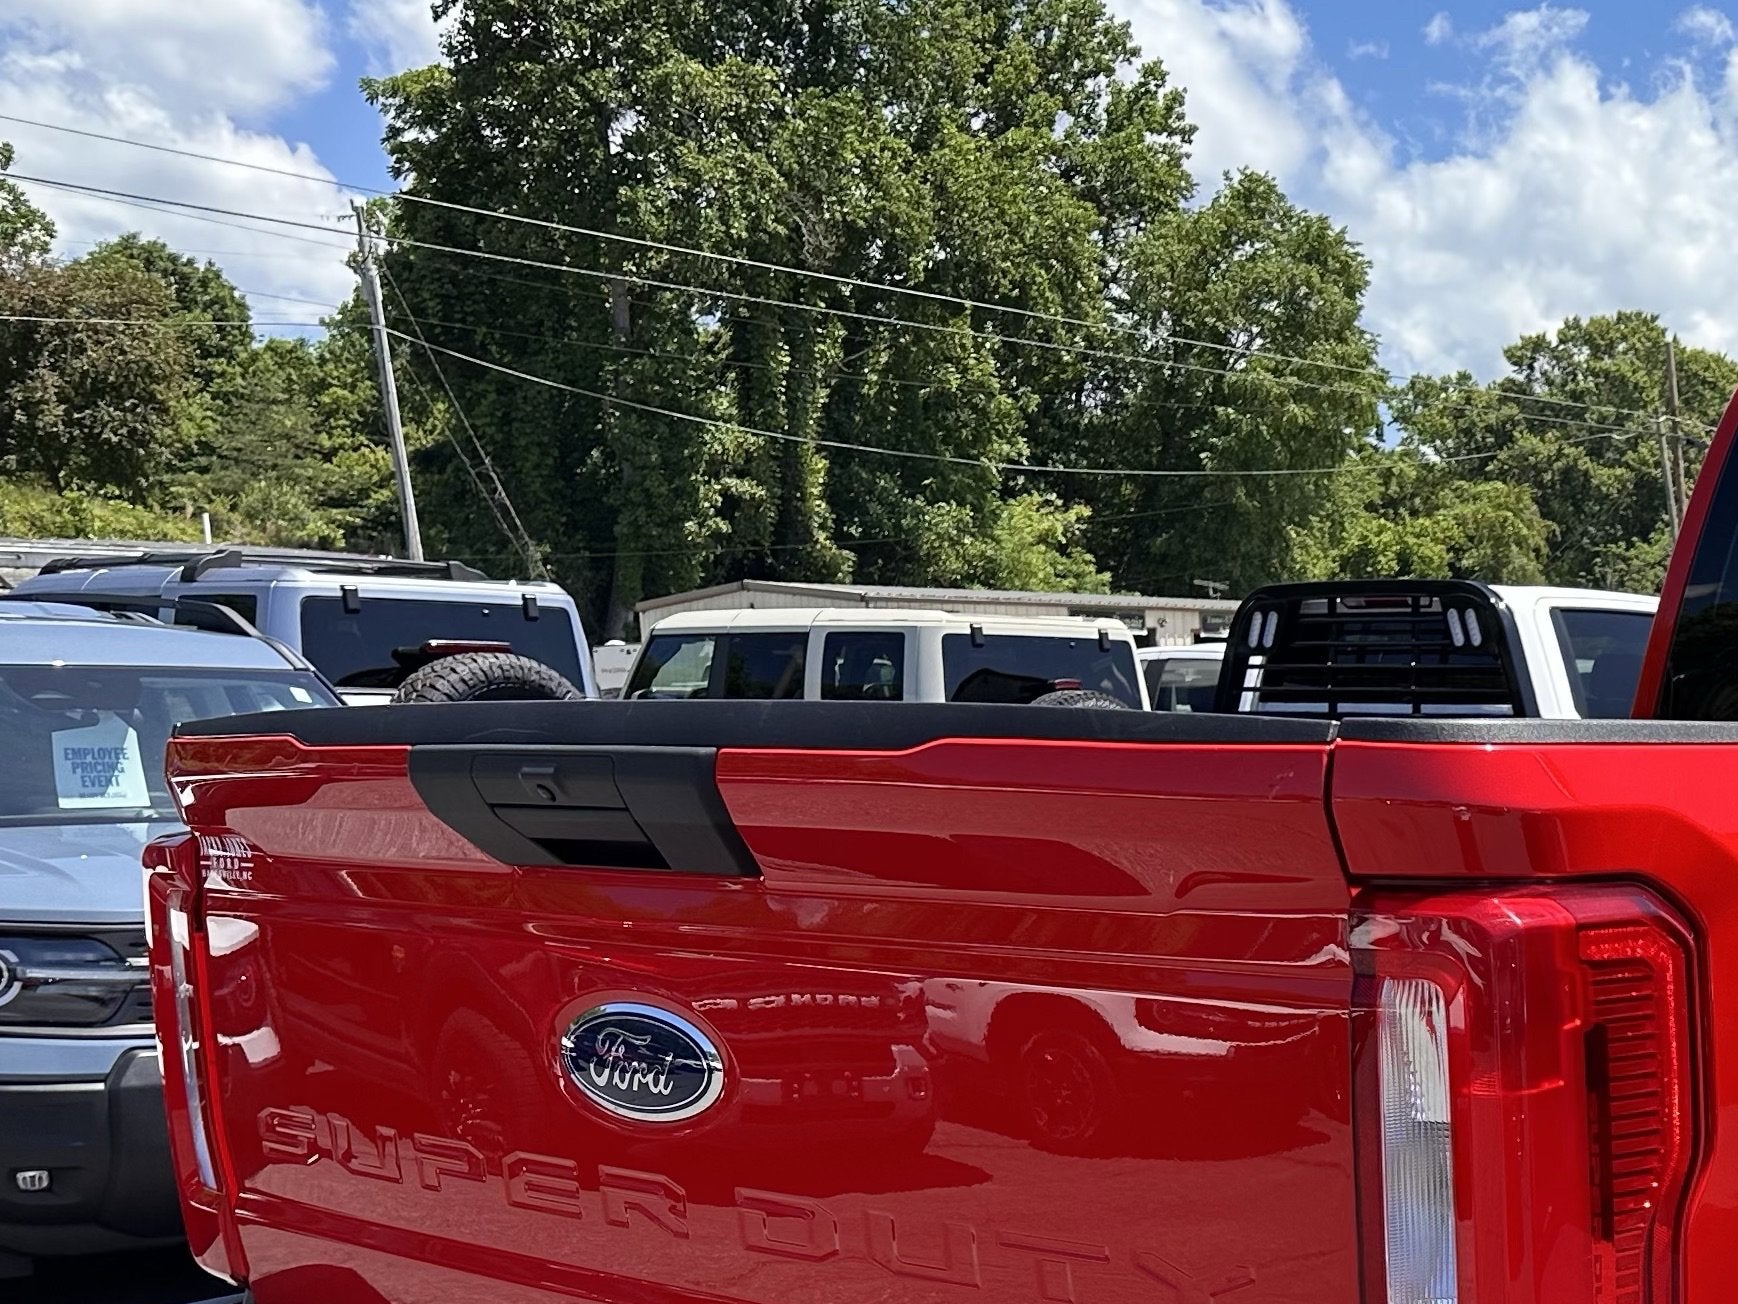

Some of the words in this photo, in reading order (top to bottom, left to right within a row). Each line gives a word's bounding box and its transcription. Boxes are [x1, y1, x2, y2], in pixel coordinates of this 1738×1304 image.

[64, 747, 130, 761] EMPLOYEE
[71, 761, 125, 774] PRICING
[80, 775, 121, 788] EVENT
[213, 857, 239, 870] FORD
[590, 1027, 675, 1096] Ford
[256, 1105, 690, 1239] SUPER
